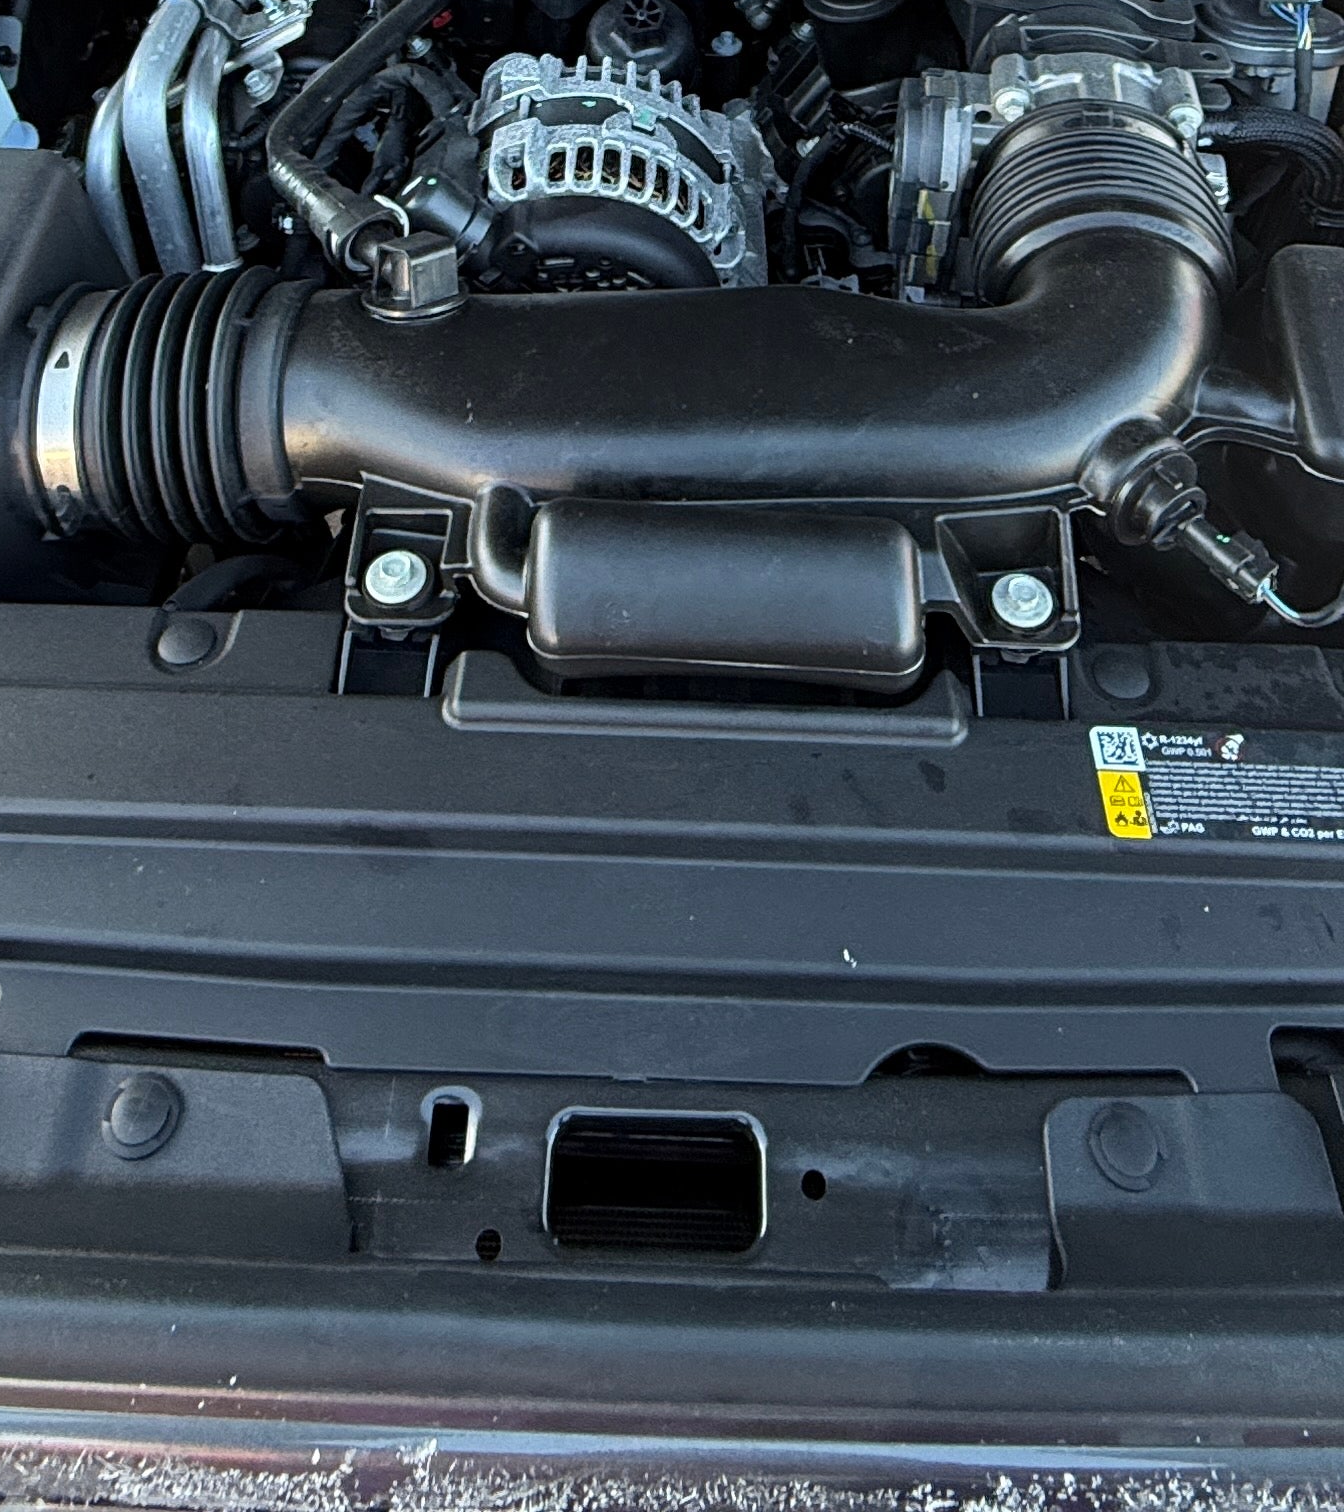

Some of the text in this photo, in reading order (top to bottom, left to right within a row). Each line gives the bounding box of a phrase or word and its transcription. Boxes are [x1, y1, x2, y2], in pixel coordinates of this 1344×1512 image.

[1161, 746, 1186, 756] GWP
[1181, 822, 1206, 834] PAG
[1252, 825, 1278, 837] GWP
[1281, 827, 1290, 837] &
[1291, 827, 1316, 838] CO2
[1316, 830, 1334, 840] per
